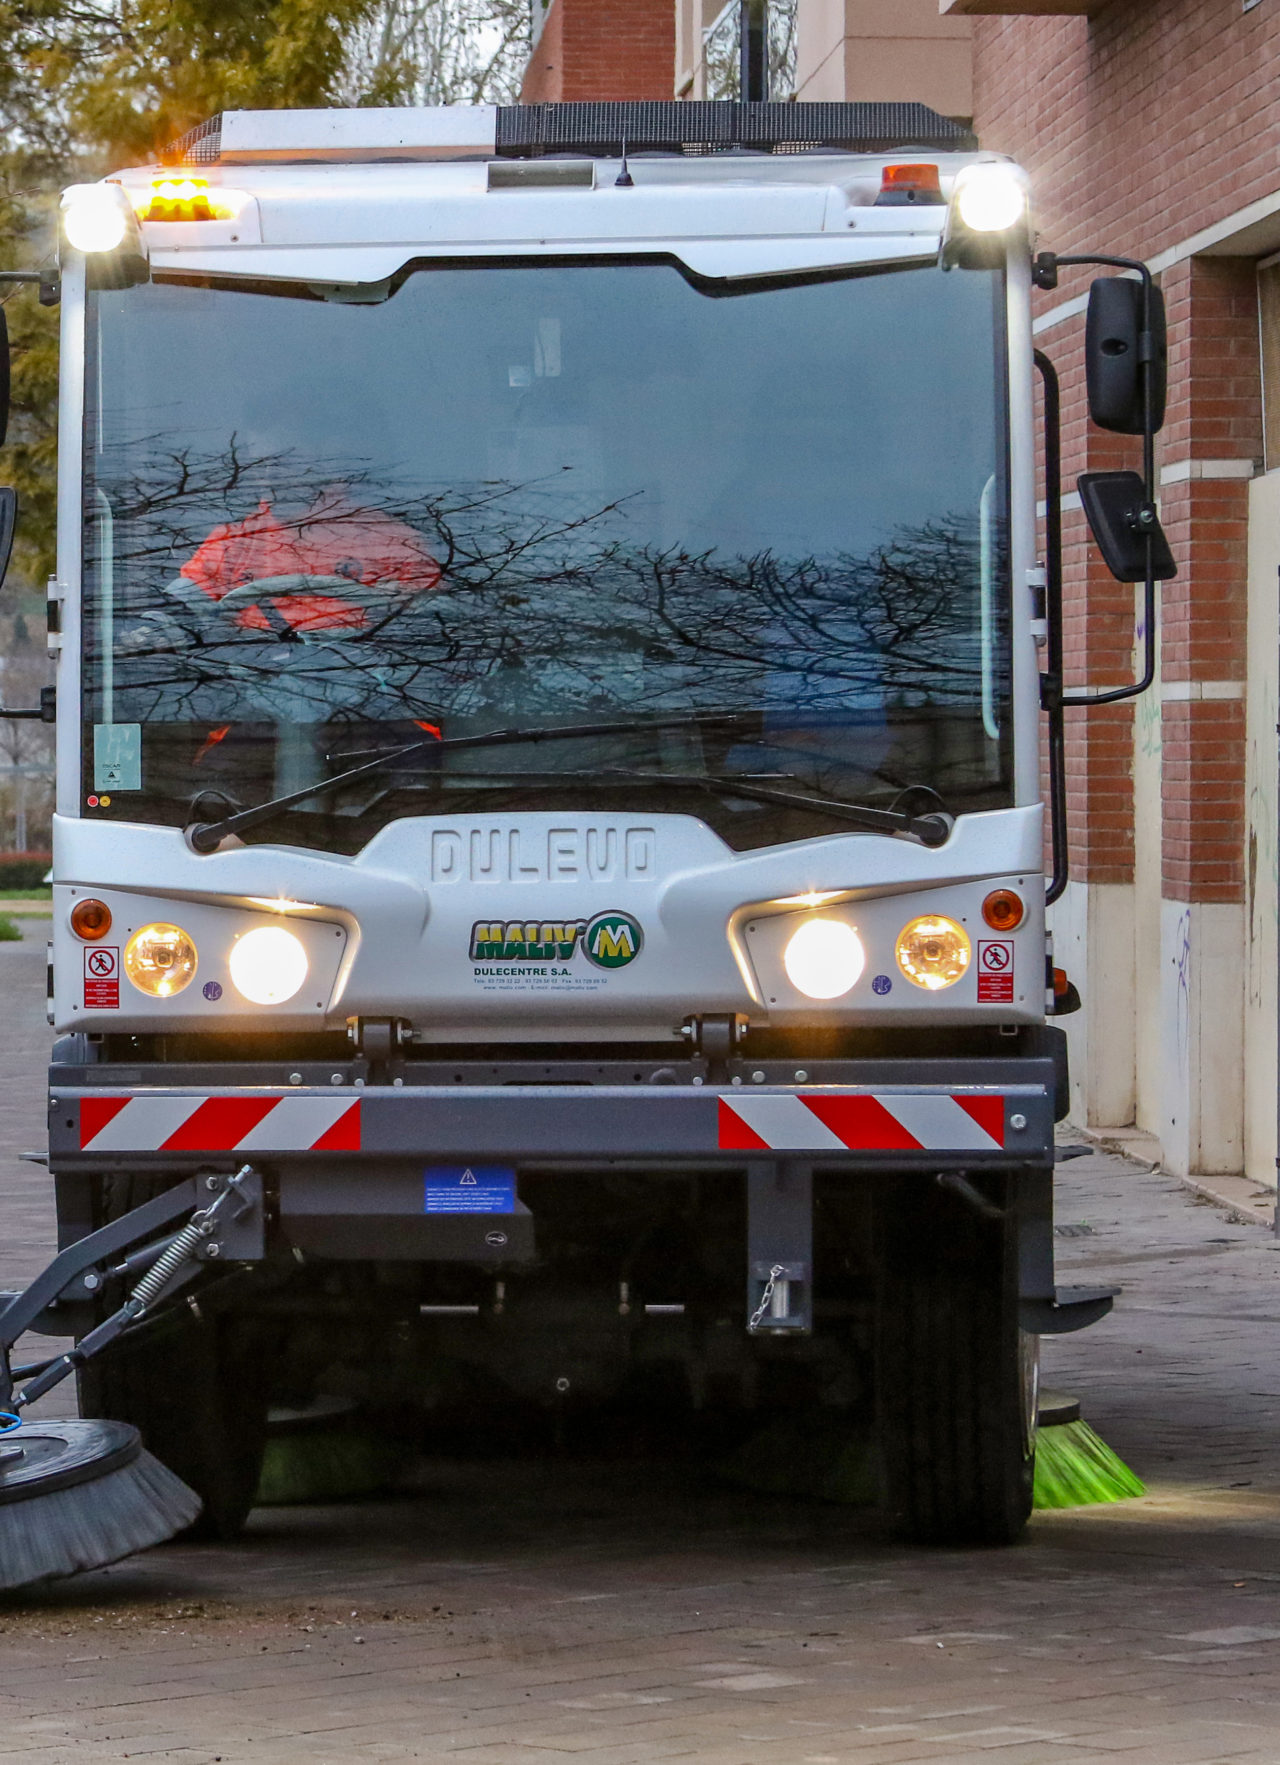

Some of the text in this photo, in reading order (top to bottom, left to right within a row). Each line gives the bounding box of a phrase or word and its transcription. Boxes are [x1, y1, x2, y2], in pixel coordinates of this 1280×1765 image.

[431, 827, 657, 884] DULEVO
[473, 967, 572, 976] DULECENTRE S.A.
